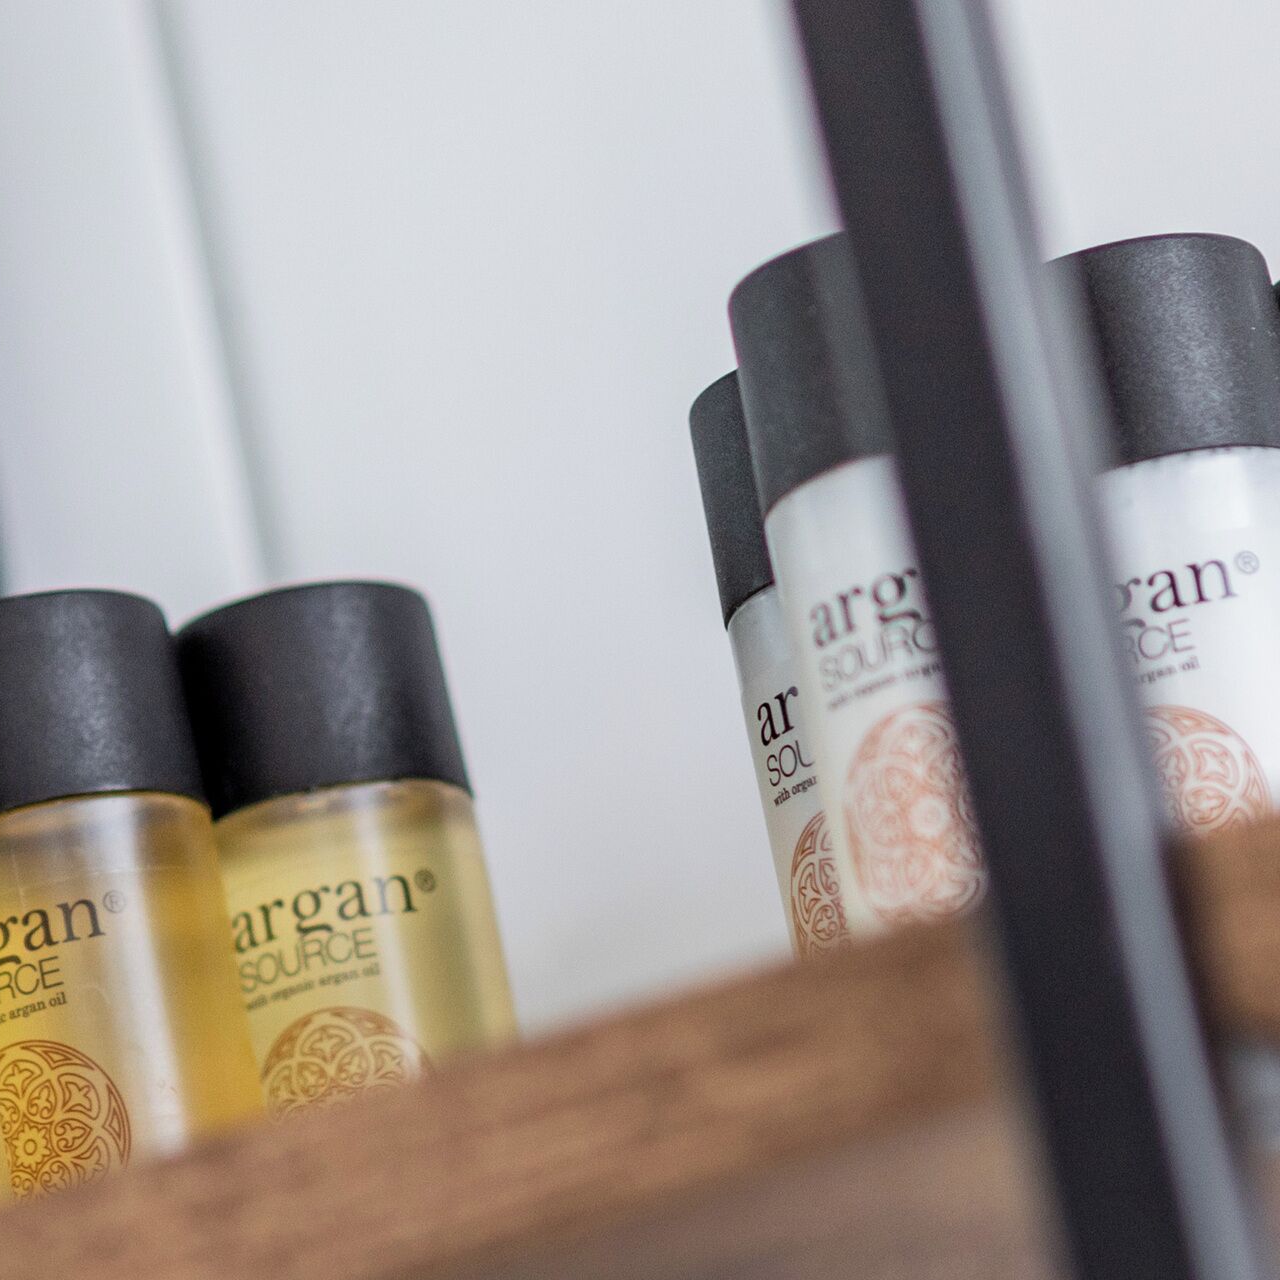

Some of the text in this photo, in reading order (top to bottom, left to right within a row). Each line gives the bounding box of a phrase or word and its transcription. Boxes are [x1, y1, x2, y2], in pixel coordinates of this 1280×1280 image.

[1139, 655, 1201, 685] rgan oil
[773, 787, 792, 808] with
[239, 928, 379, 993] SOURCE
[8, 1000, 47, 1020] argan
[49, 991, 68, 1008] oil
